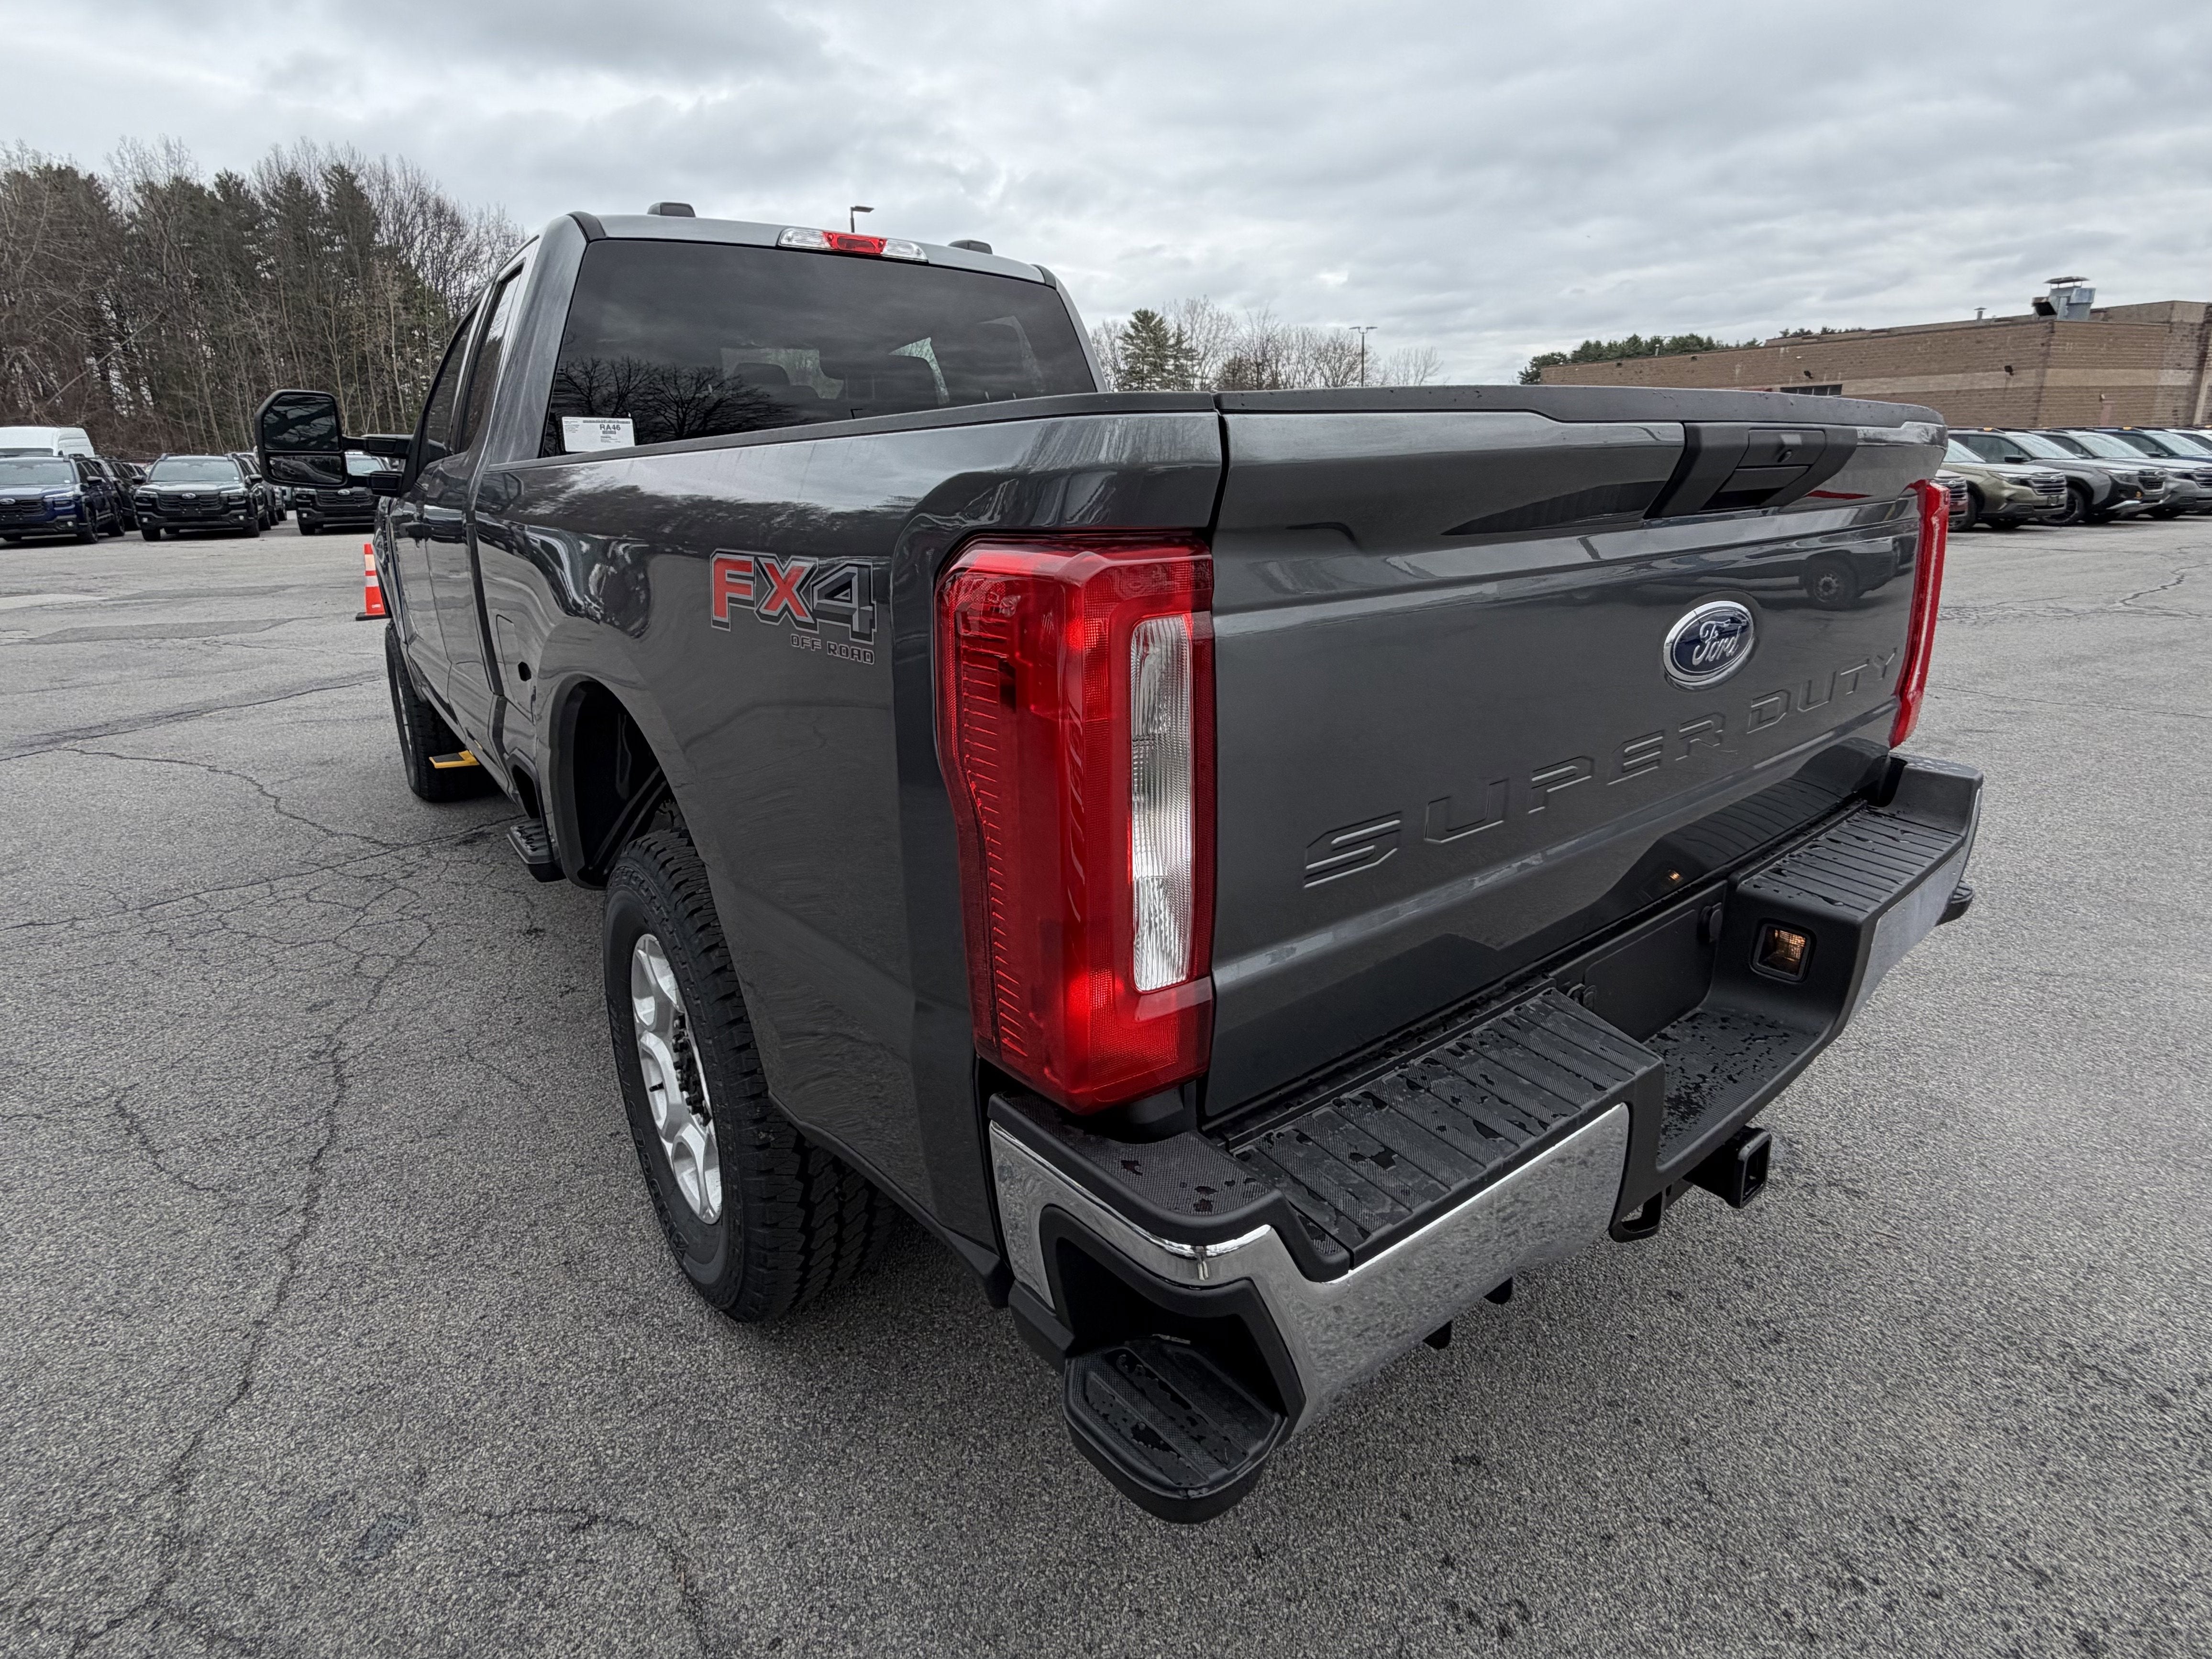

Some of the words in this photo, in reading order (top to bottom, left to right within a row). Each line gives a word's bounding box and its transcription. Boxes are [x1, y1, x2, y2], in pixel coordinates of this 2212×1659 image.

[710, 548, 877, 645] FX4
[790, 633, 821, 651] OFF
[827, 641, 875, 665] ROAD
[1692, 619, 1742, 665] Ford
[1304, 711, 1725, 888] SUPER
[1747, 647, 1898, 735] DUTY
